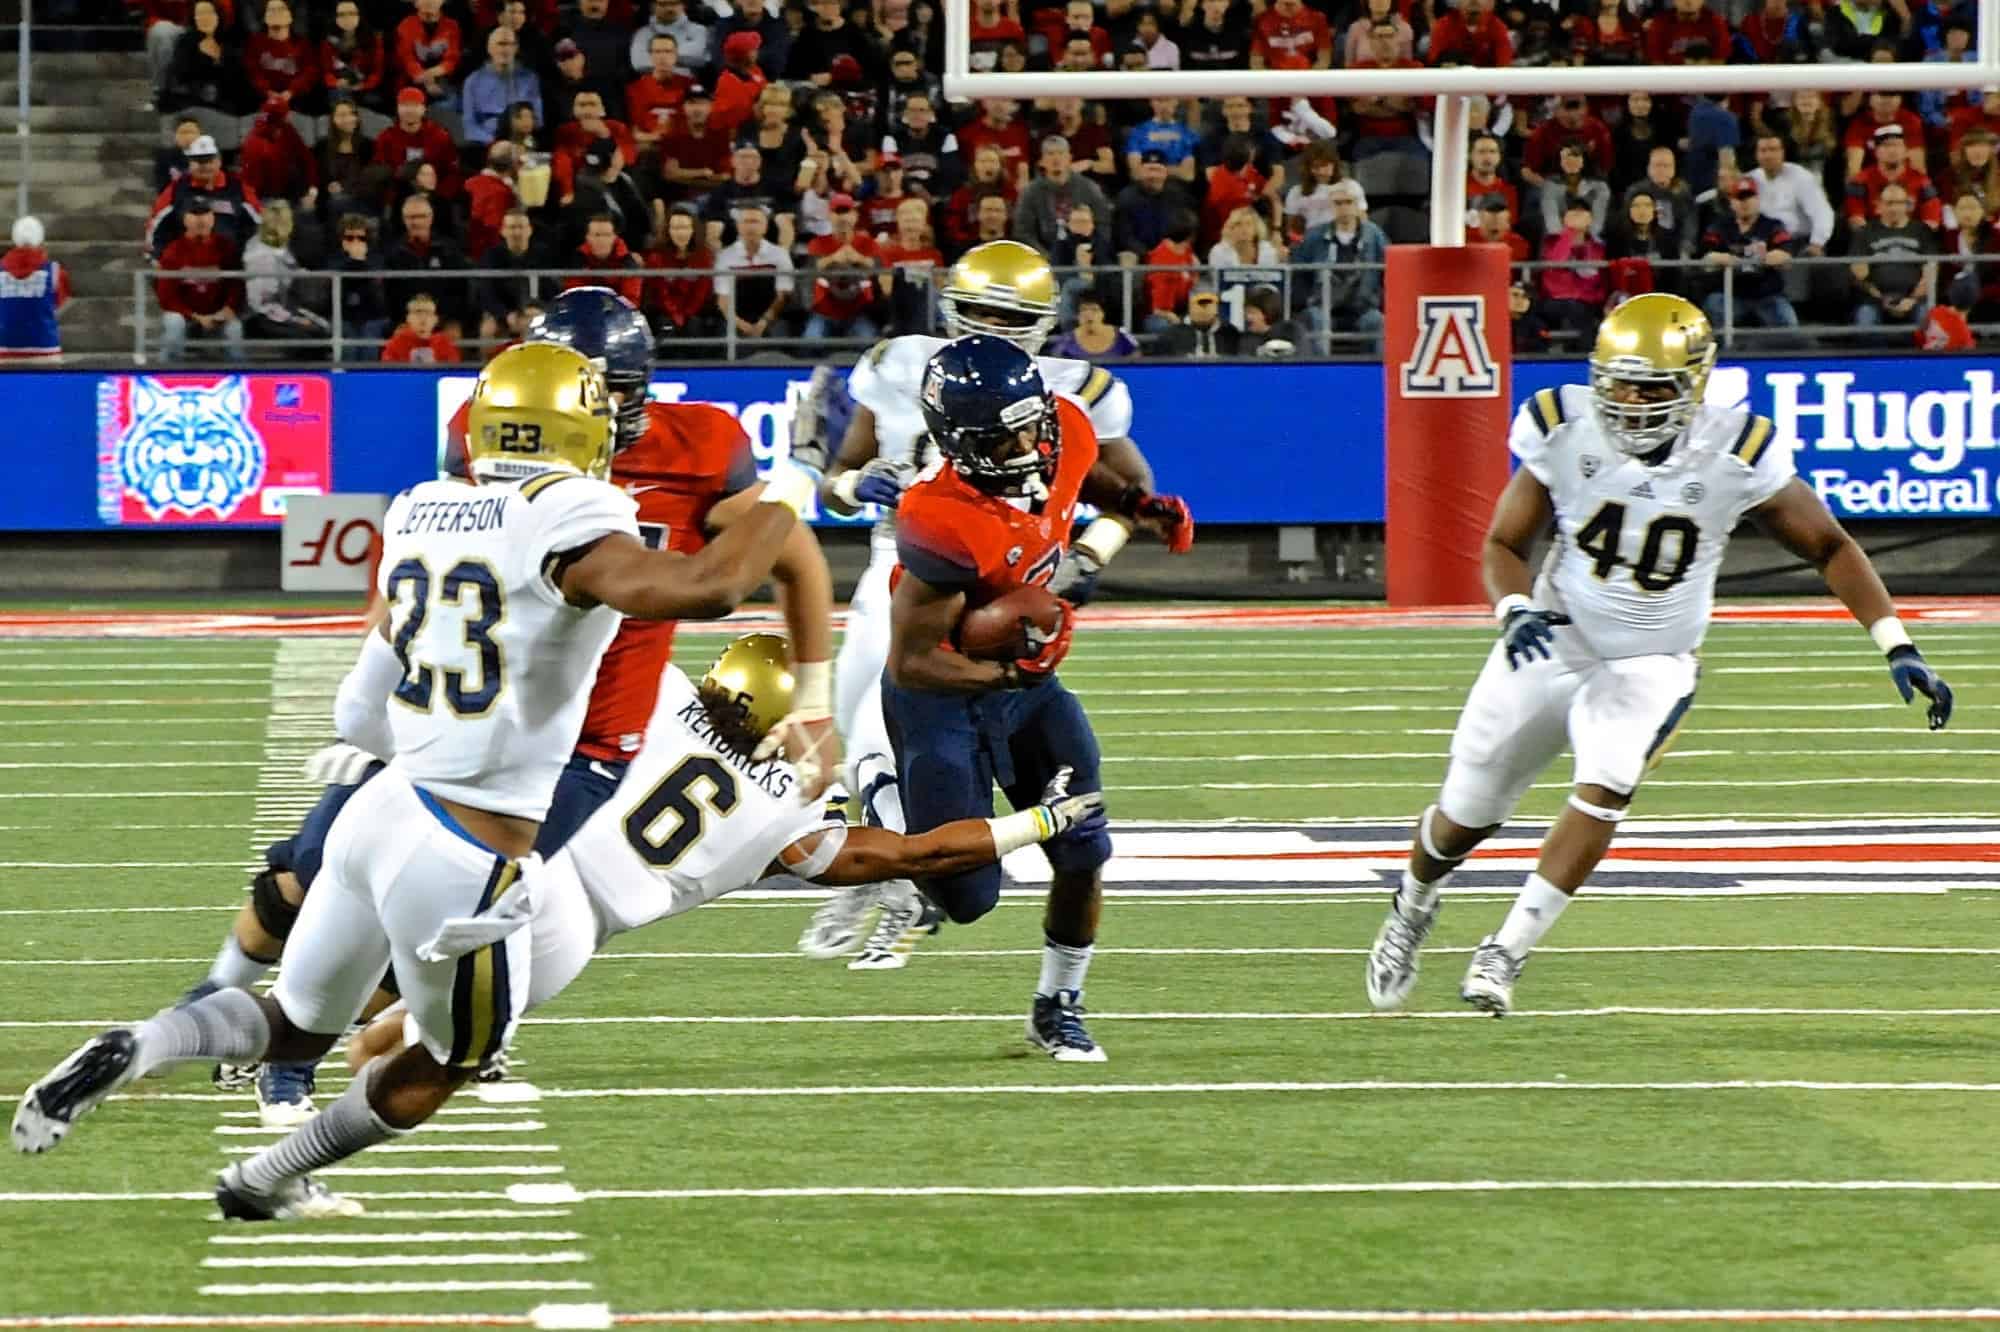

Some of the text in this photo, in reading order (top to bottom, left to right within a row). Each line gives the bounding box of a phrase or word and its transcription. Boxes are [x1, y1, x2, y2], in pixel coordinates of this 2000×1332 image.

[1400, 295, 1501, 398] A
[501, 422, 541, 453] 23
[396, 495, 509, 536] JEFFERSON
[1810, 467, 1992, 513] Federal
[1575, 499, 1702, 593] 40
[386, 555, 507, 721] 23
[621, 753, 742, 871] 6
